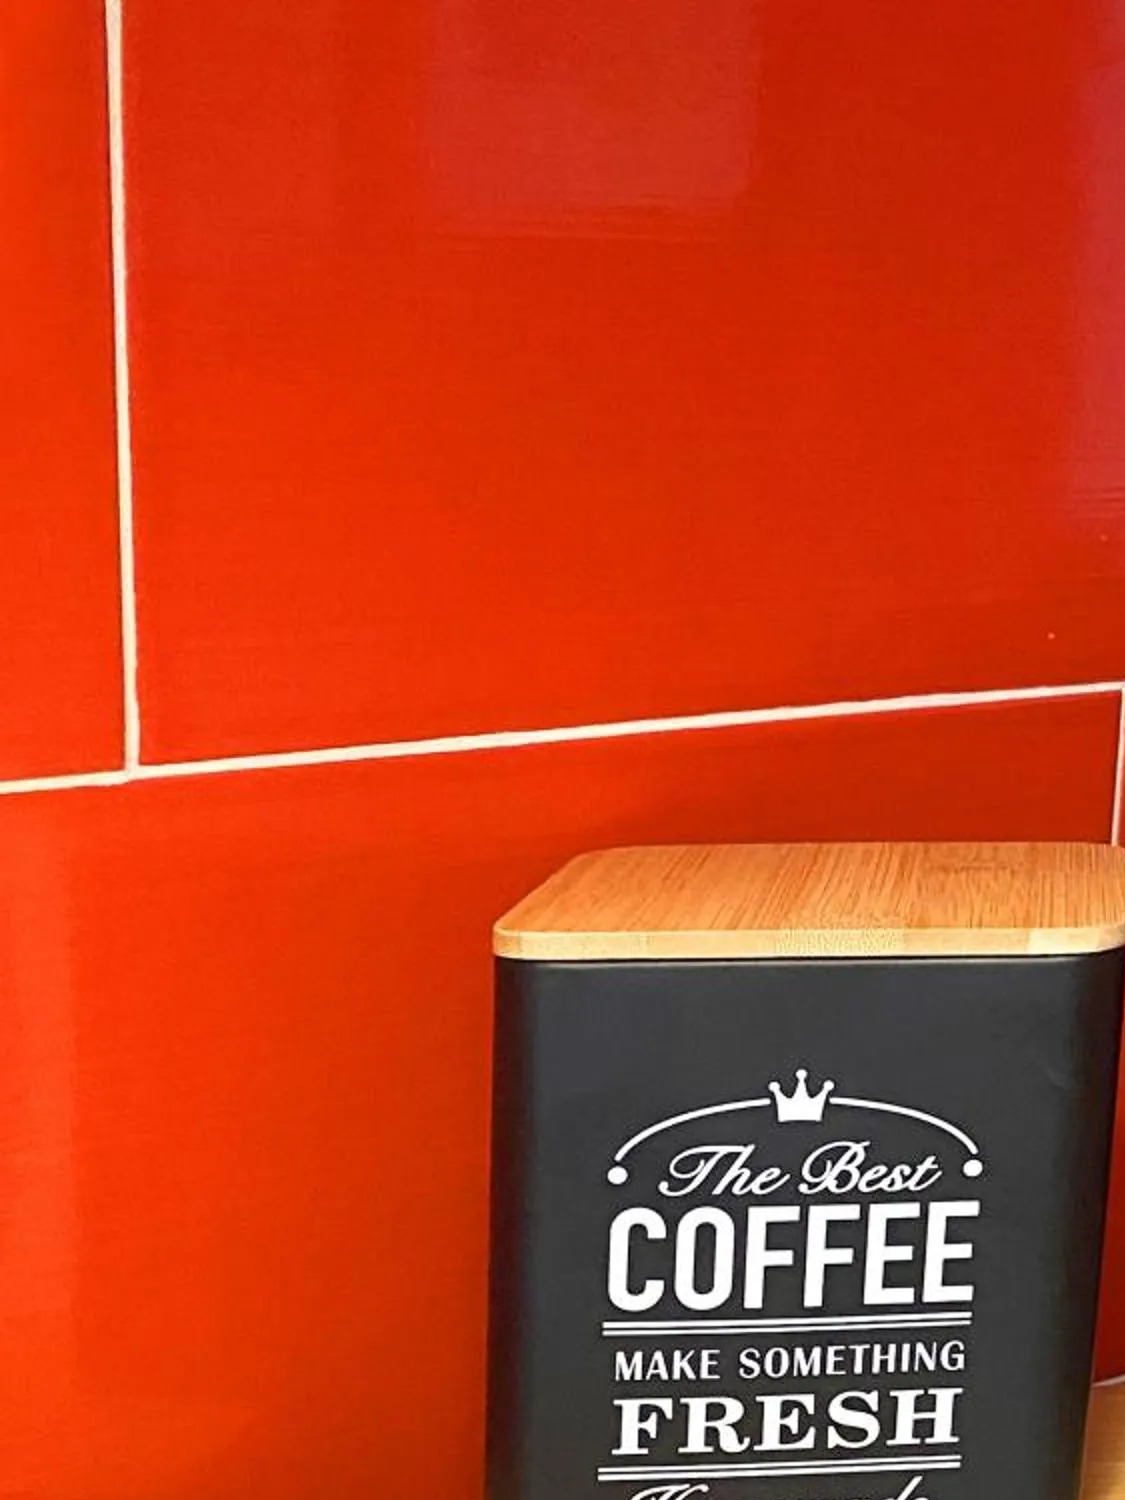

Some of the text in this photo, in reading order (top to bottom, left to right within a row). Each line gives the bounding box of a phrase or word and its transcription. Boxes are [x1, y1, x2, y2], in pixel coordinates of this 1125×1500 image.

[659, 1141, 943, 1197] The Best
[608, 1201, 980, 1312] COFFEE
[614, 1340, 966, 1381] MAKE SOMETHING
[611, 1388, 963, 1456] FRESH
